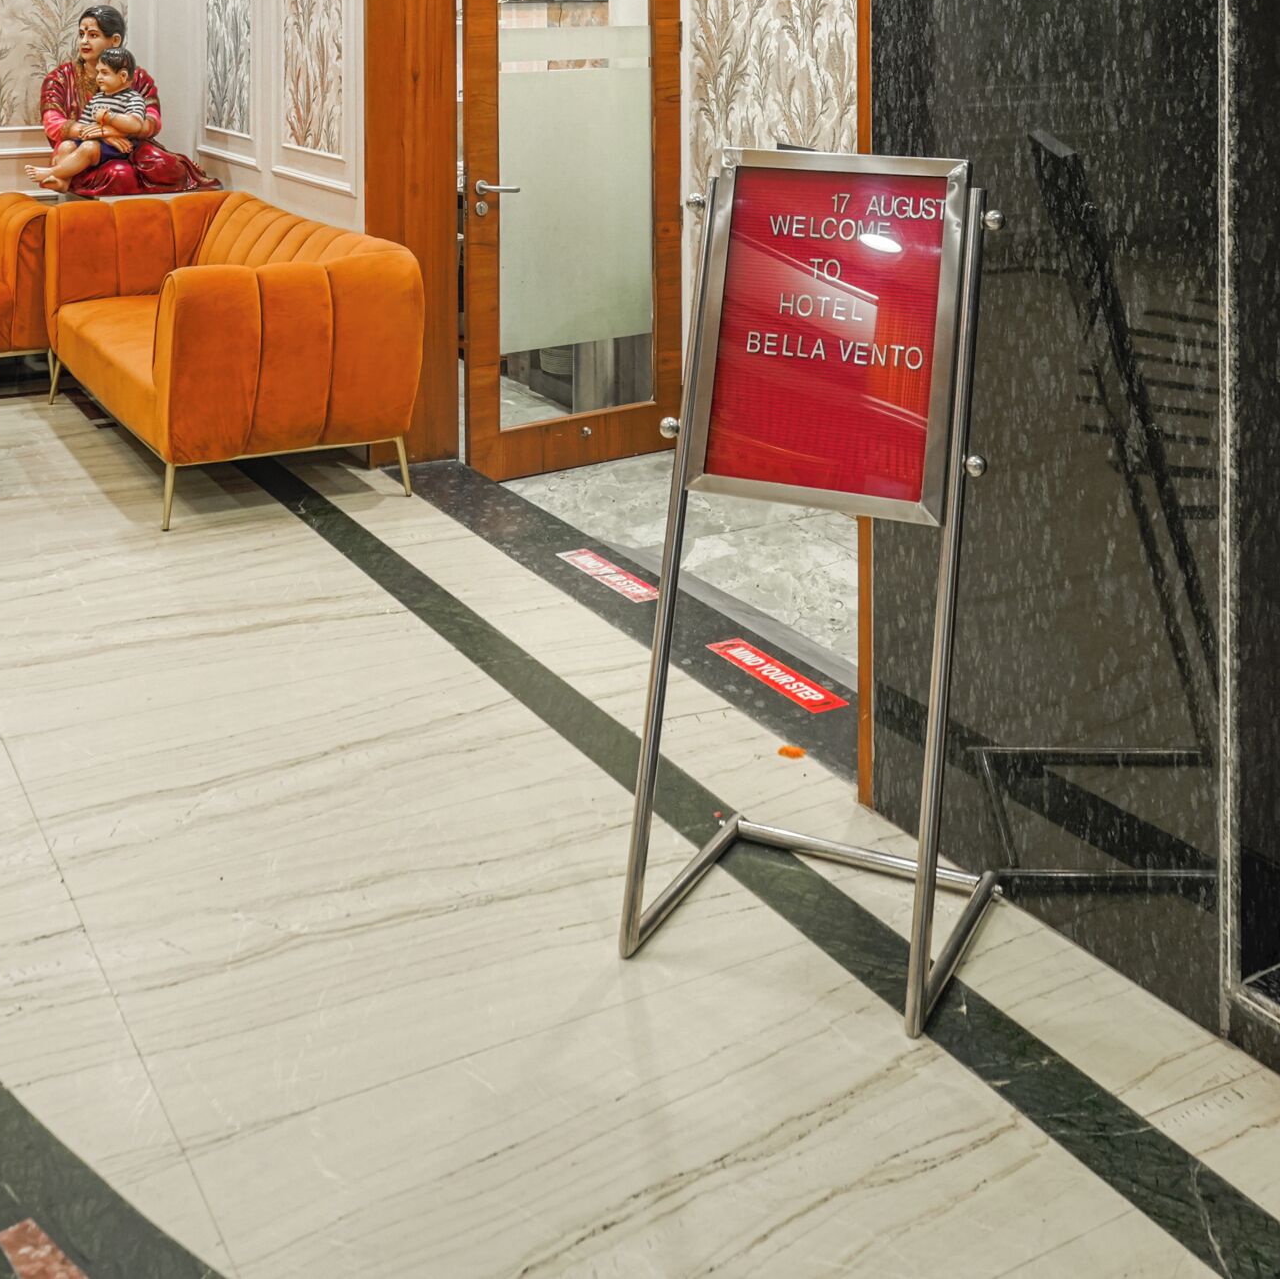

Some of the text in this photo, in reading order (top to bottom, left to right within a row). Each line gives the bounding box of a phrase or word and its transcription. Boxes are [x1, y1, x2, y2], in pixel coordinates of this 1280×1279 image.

[831, 193, 946, 220] 17 AUGUST
[809, 258, 841, 280] TO
[779, 293, 863, 321] HOTEL
[746, 331, 924, 370] BELLA VENTO
[727, 647, 825, 701] MIND YOUR STEP
